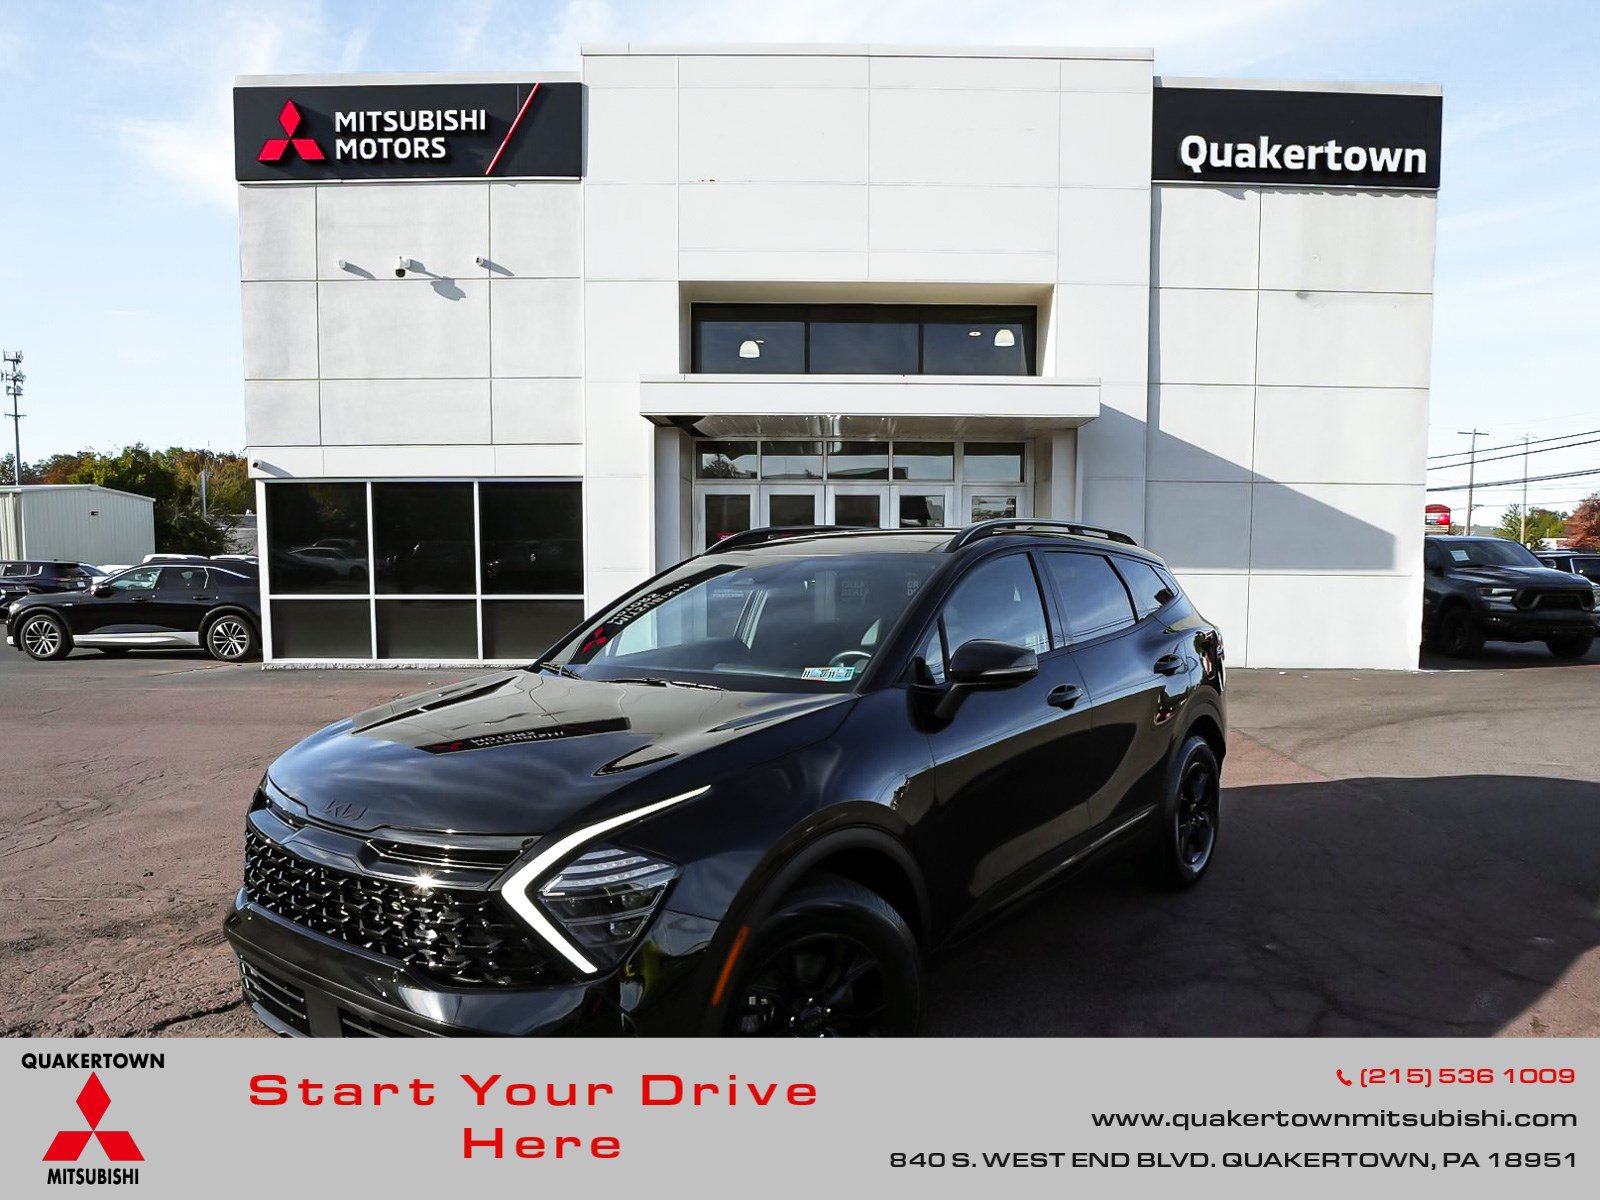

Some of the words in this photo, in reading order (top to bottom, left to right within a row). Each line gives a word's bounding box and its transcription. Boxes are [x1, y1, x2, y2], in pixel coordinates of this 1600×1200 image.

[334, 109, 486, 133] MITSUBISHI
[335, 137, 446, 160] MOTORS
[1180, 135, 1427, 174] Quakertown
